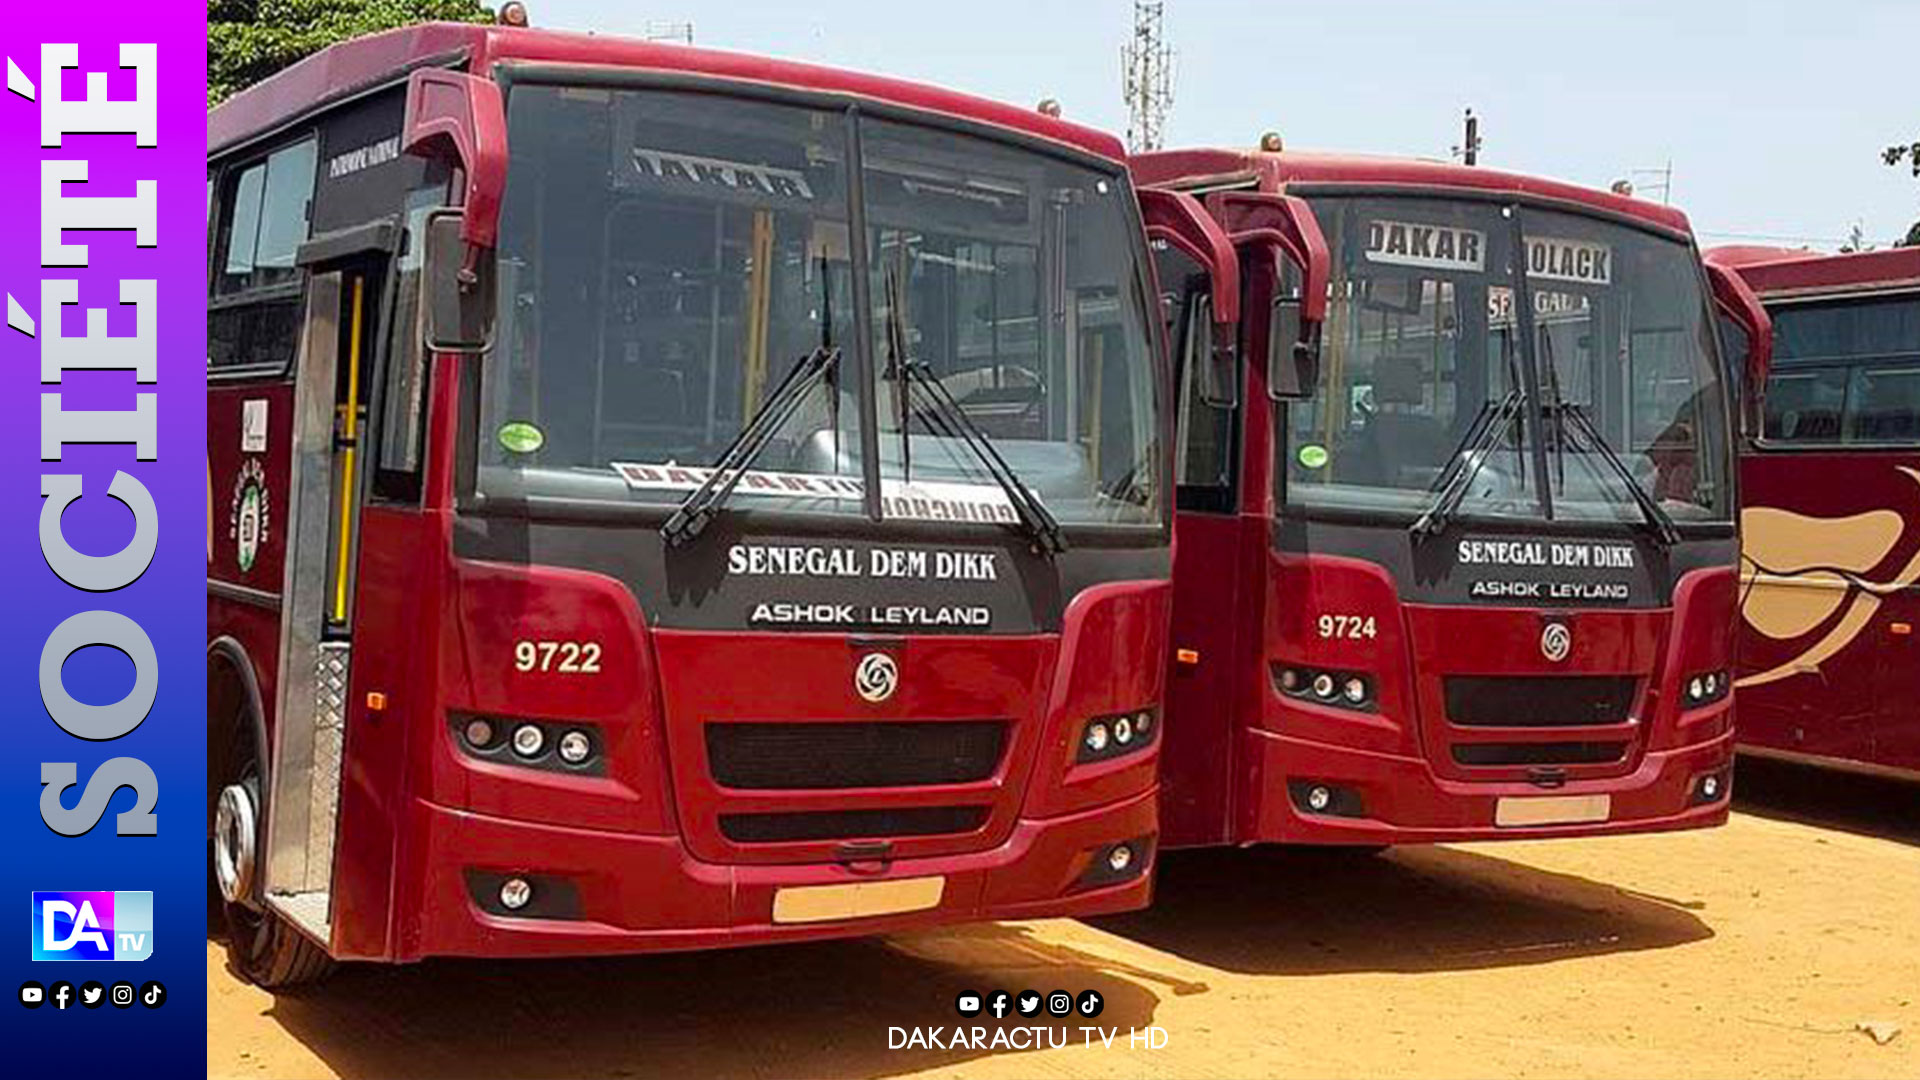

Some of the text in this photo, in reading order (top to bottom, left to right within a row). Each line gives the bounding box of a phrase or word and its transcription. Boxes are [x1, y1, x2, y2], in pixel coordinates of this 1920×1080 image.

[1369, 221, 1480, 264] DAKAR
[728, 545, 997, 580] SENEGAL DEM DIKK
[1458, 540, 1634, 568] SENEGAL DEM DIKK
[1472, 582, 1629, 598] ASHOK LEYLAND
[751, 604, 989, 625] ASHOK LEYLAND
[1318, 614, 1377, 638] 9724
[515, 641, 602, 672] 9722
